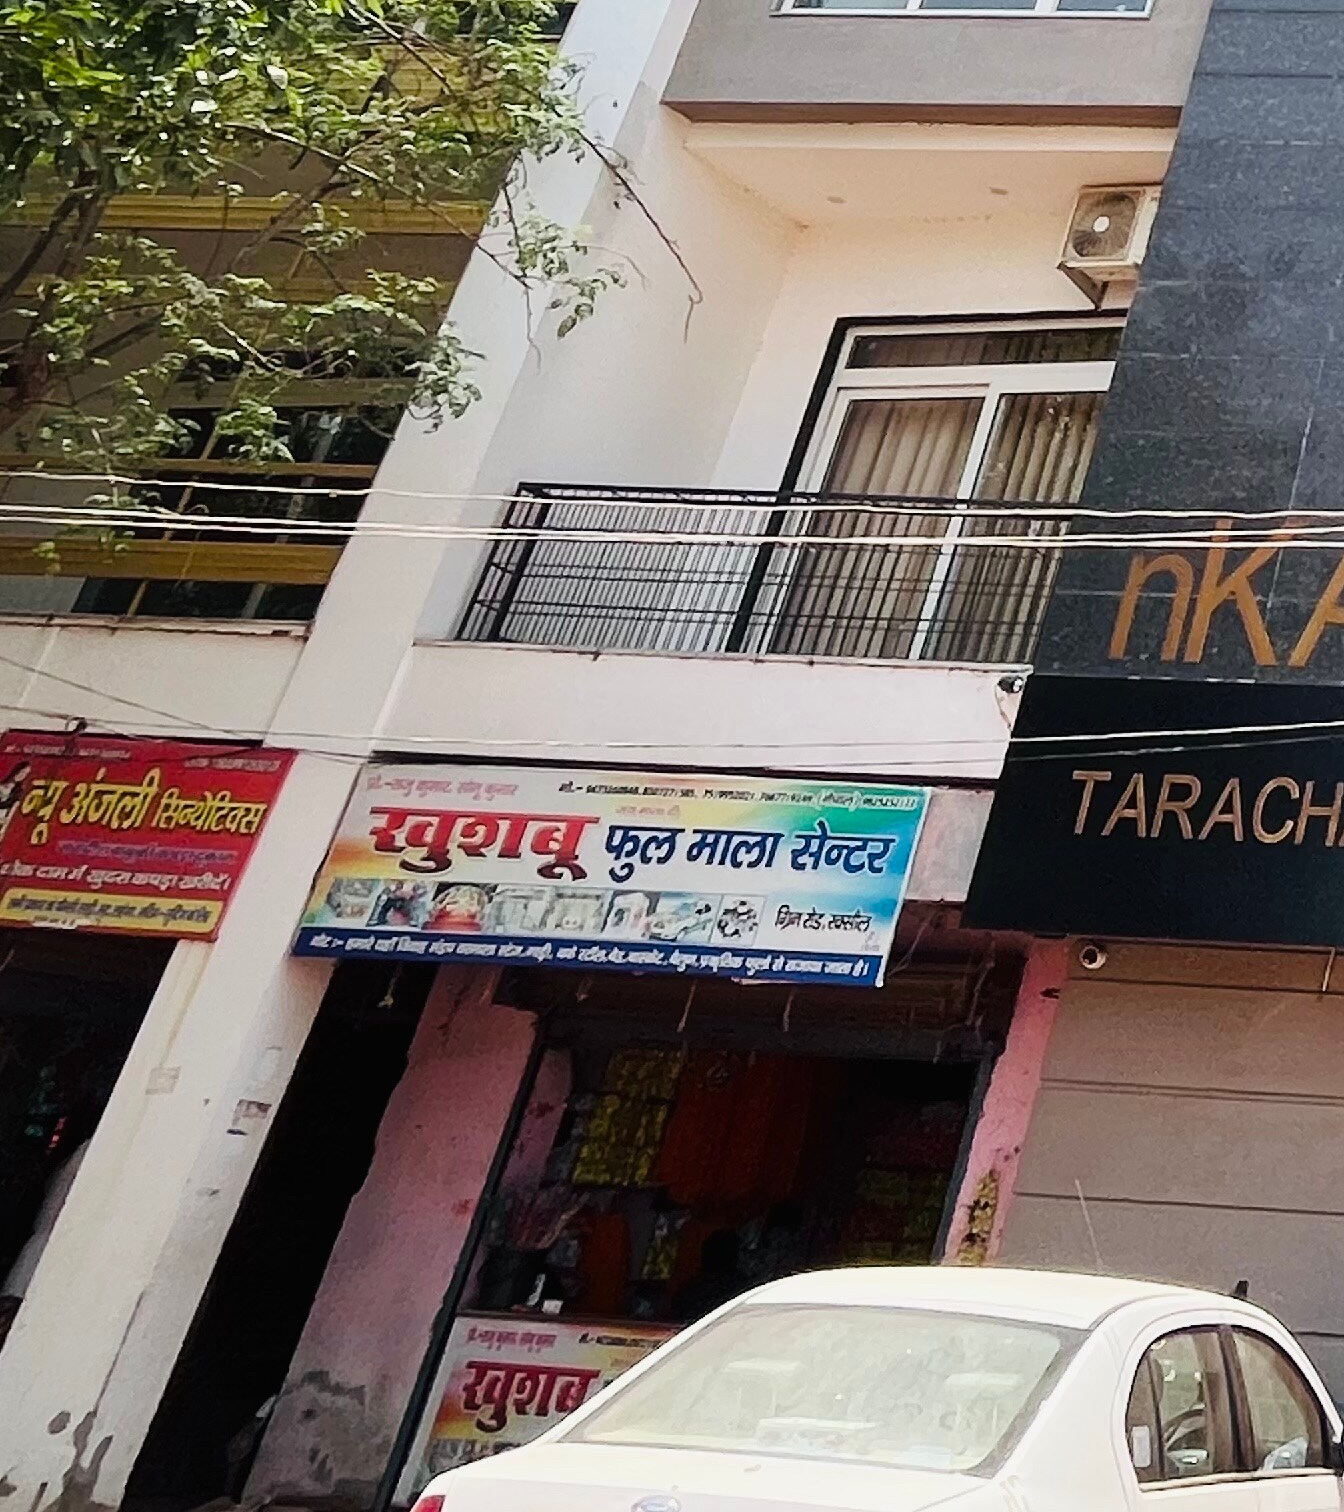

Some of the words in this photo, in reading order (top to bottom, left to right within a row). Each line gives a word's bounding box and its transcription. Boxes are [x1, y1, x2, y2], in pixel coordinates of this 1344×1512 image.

[59, 767, 162, 830] अंजली
[369, 806, 599, 882] खुशबू
[605, 824, 685, 883] फुल
[686, 828, 784, 869] माला
[791, 820, 895, 874] सेन्टर
[462, 1360, 600, 1432] खुशब
